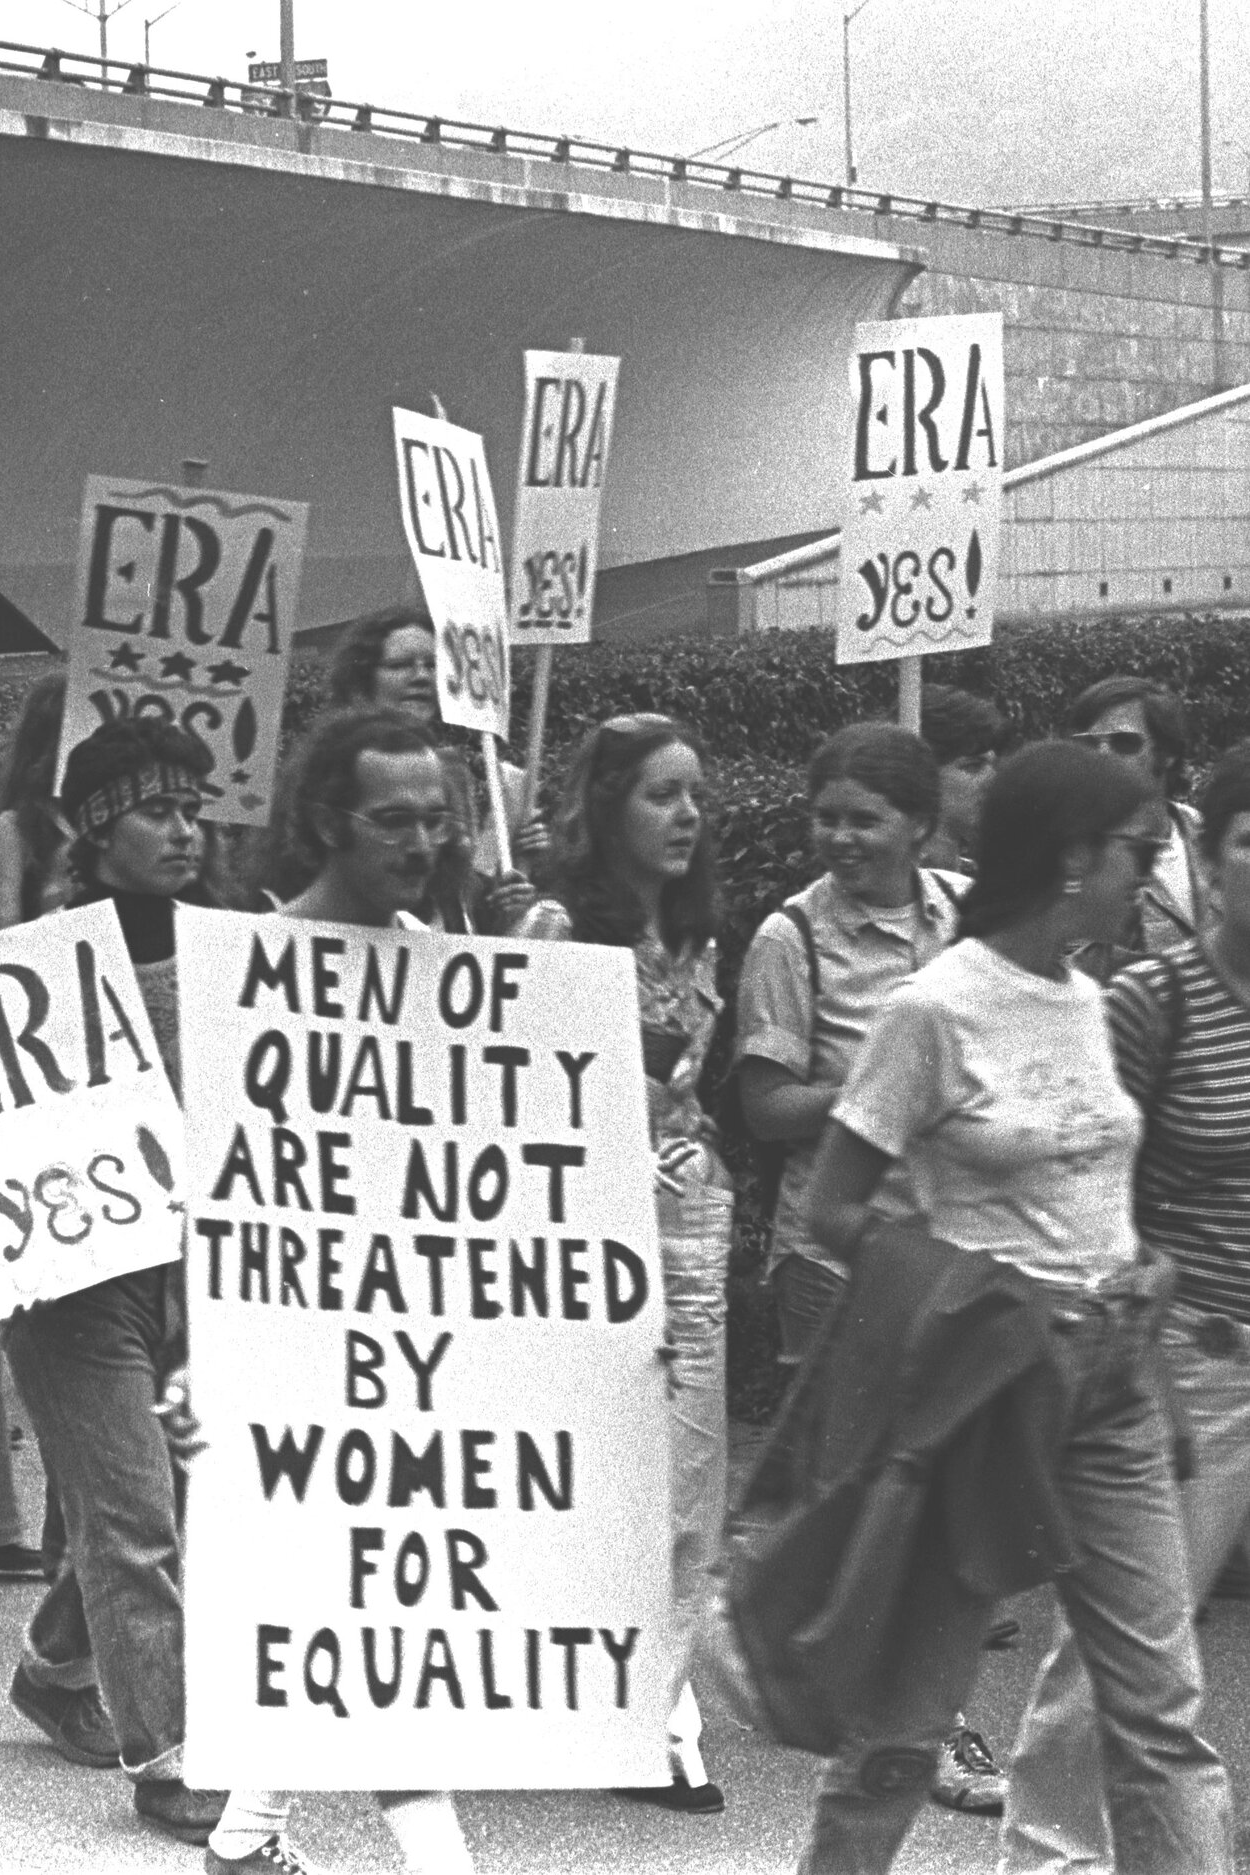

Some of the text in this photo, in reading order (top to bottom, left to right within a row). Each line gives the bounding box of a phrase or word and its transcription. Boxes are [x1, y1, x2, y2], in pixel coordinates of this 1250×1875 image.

[252, 65, 278, 79] EAST
[525, 376, 607, 488] ERA
[852, 343, 998, 481] ERA
[402, 437, 500, 573] ERA
[82, 504, 281, 654] ERA
[519, 545, 587, 619] YES!
[856, 528, 982, 631] YES!
[238, 932, 529, 1033] MEN OF
[244, 1029, 598, 1129] QUALITY
[210, 1123, 586, 1224] ARE NOT
[195, 1217, 649, 1323] THREATENED
[346, 1329, 453, 1412] BY
[248, 1423, 574, 1511] WOMEN
[350, 1527, 500, 1612] FOR
[256, 1624, 639, 1718] EQUALITY
